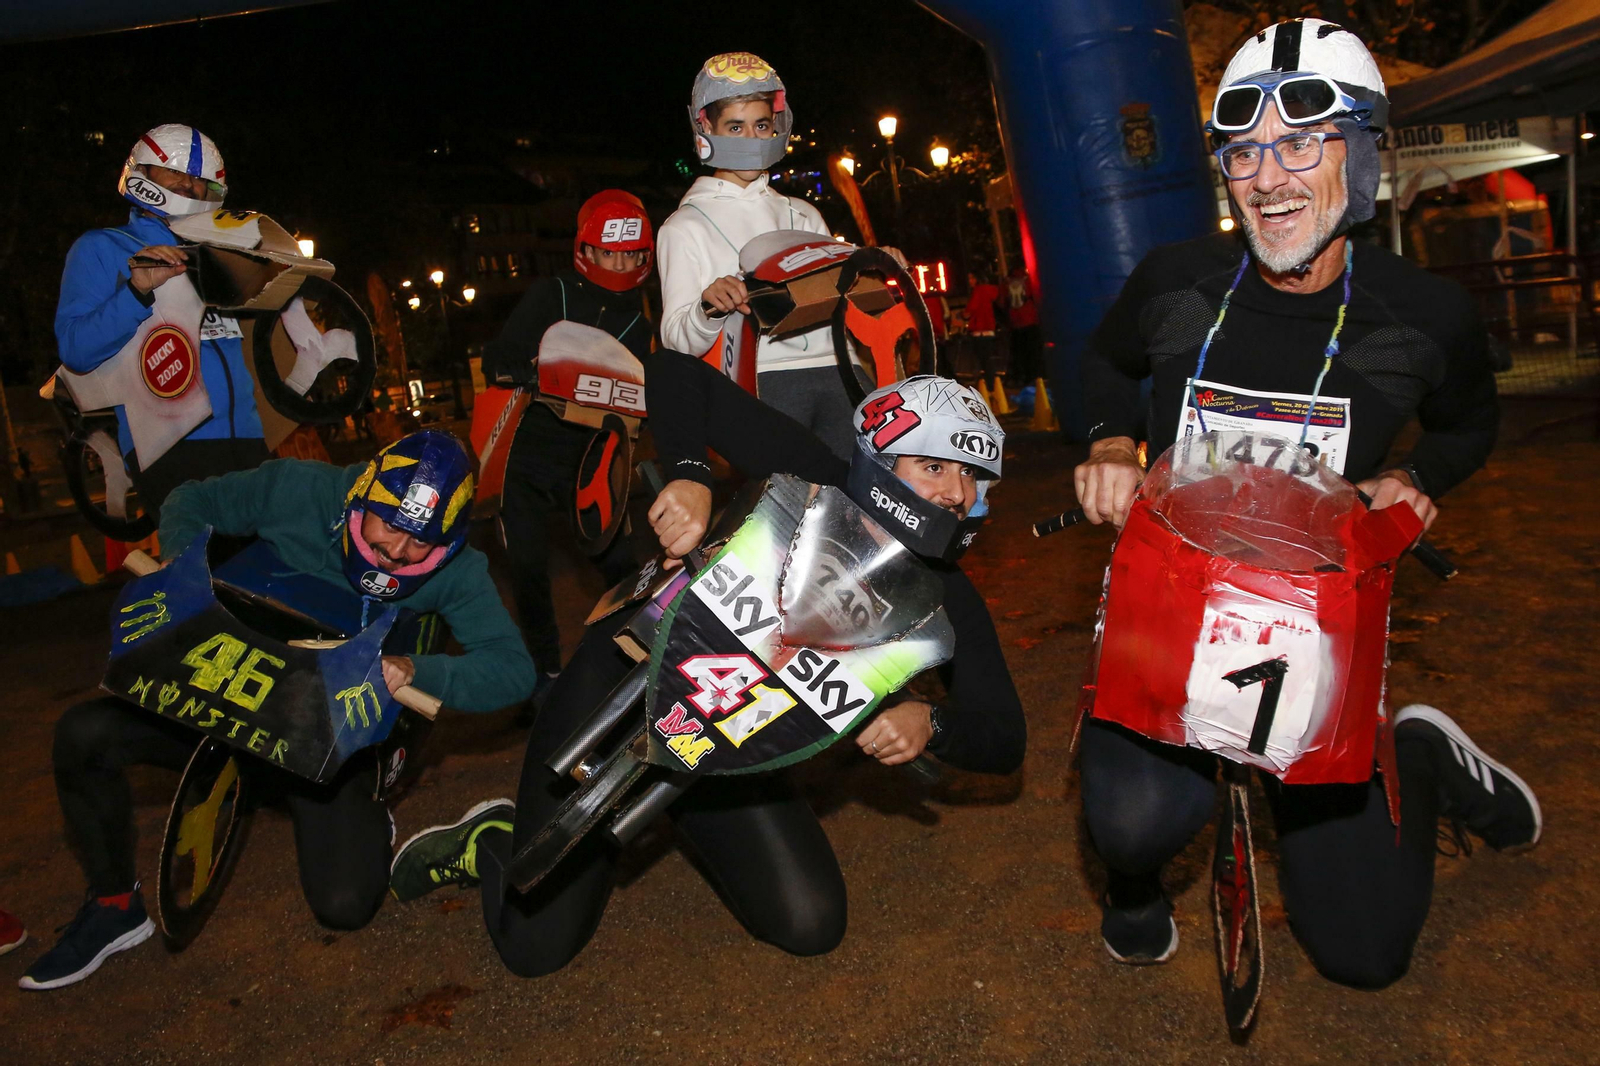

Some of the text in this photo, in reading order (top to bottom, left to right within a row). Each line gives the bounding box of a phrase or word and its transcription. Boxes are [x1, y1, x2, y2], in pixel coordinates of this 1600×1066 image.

[128, 180, 162, 202] Arai
[601, 218, 642, 243] 93
[147, 338, 176, 371] LUCKY
[156, 359, 184, 387] 2020
[574, 373, 647, 412] 93
[1202, 399, 1235, 408] Nocturna
[861, 391, 922, 451] 41
[957, 432, 997, 459] KYT
[400, 498, 434, 519] agv
[870, 486, 921, 531] aprilia
[362, 578, 397, 594] agv
[700, 563, 782, 636] sky
[816, 563, 870, 631] 740
[181, 632, 286, 713] 46
[786, 649, 867, 721] sky
[675, 653, 798, 749] 41
